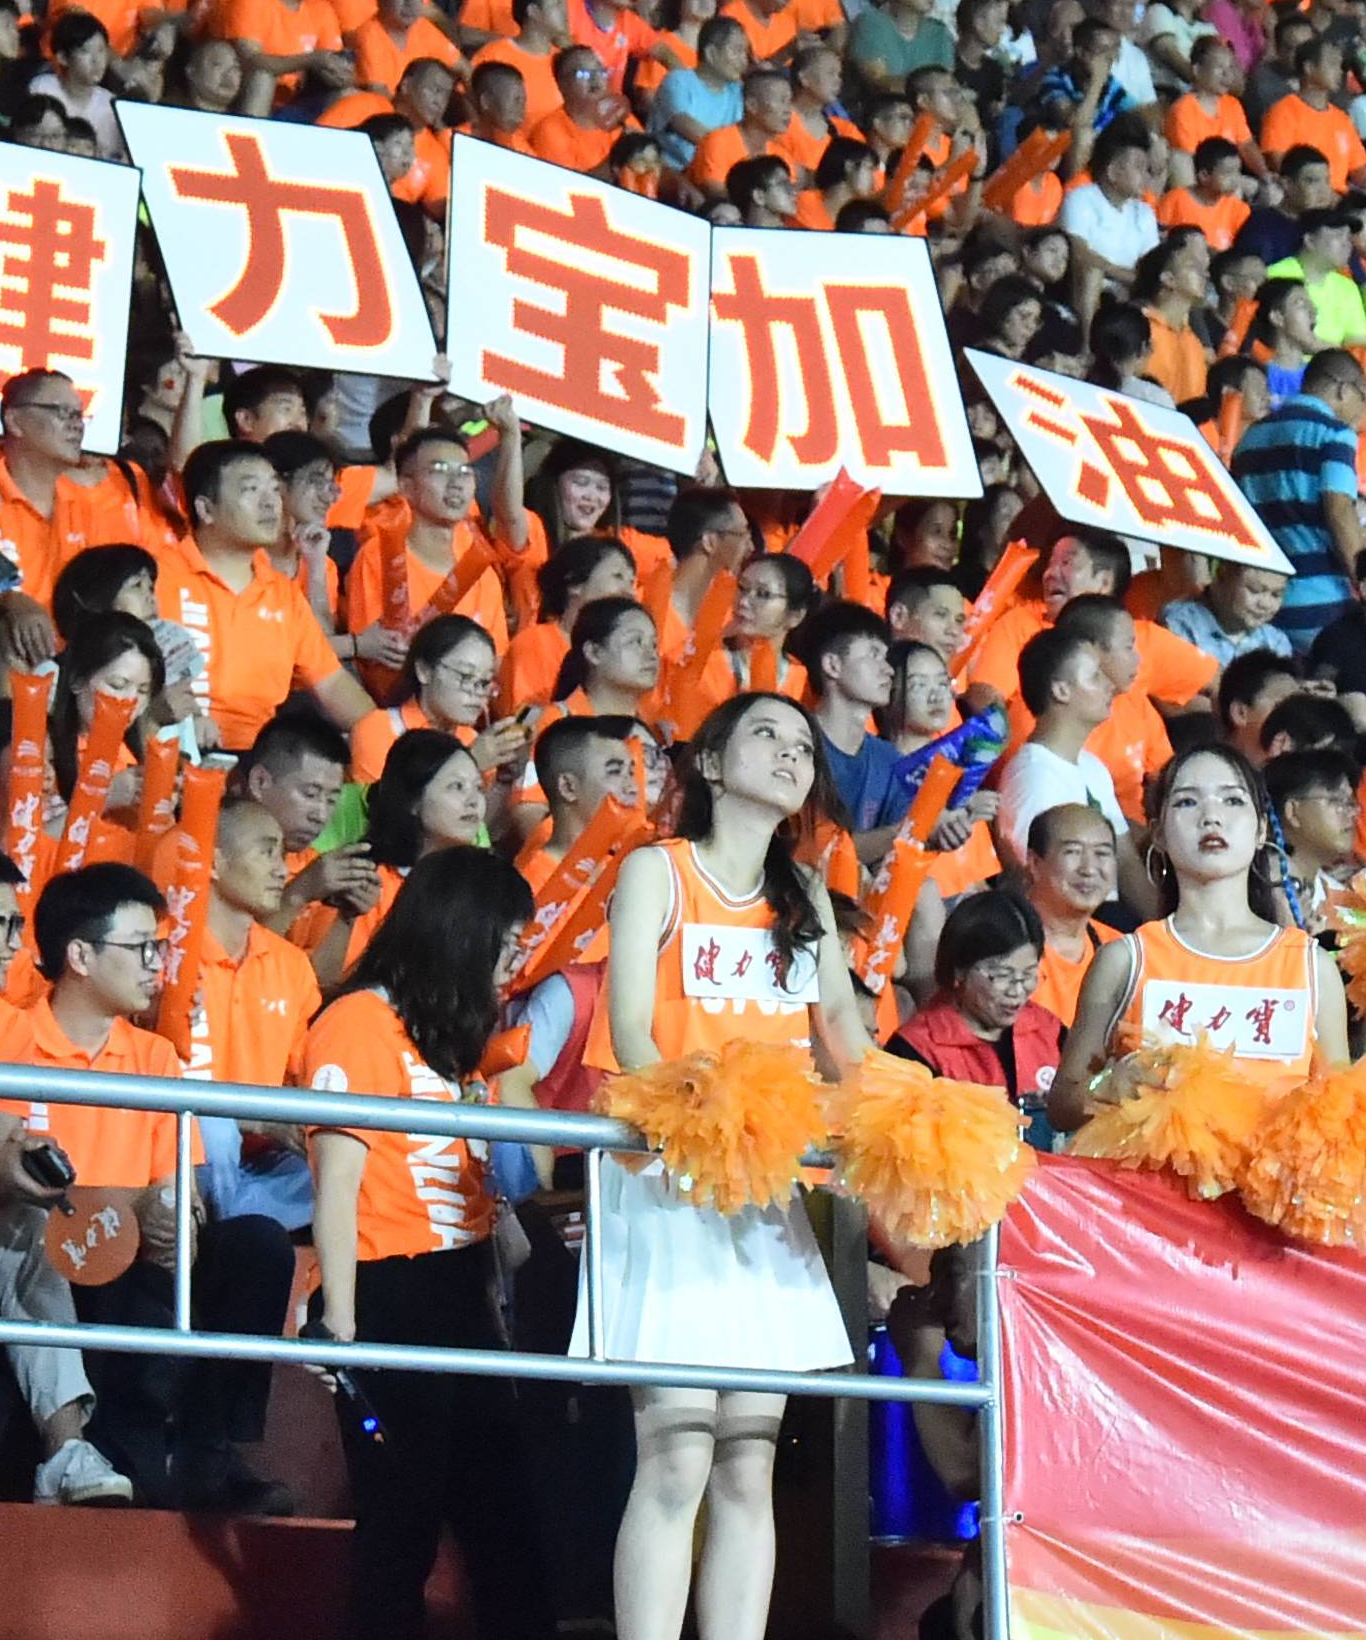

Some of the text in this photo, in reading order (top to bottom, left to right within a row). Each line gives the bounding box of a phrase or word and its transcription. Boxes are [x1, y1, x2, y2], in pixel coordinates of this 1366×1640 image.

[172, 135, 392, 347] 力
[482, 187, 689, 446] 宝
[712, 254, 947, 480] 加
[1014, 371, 1257, 547] 油
